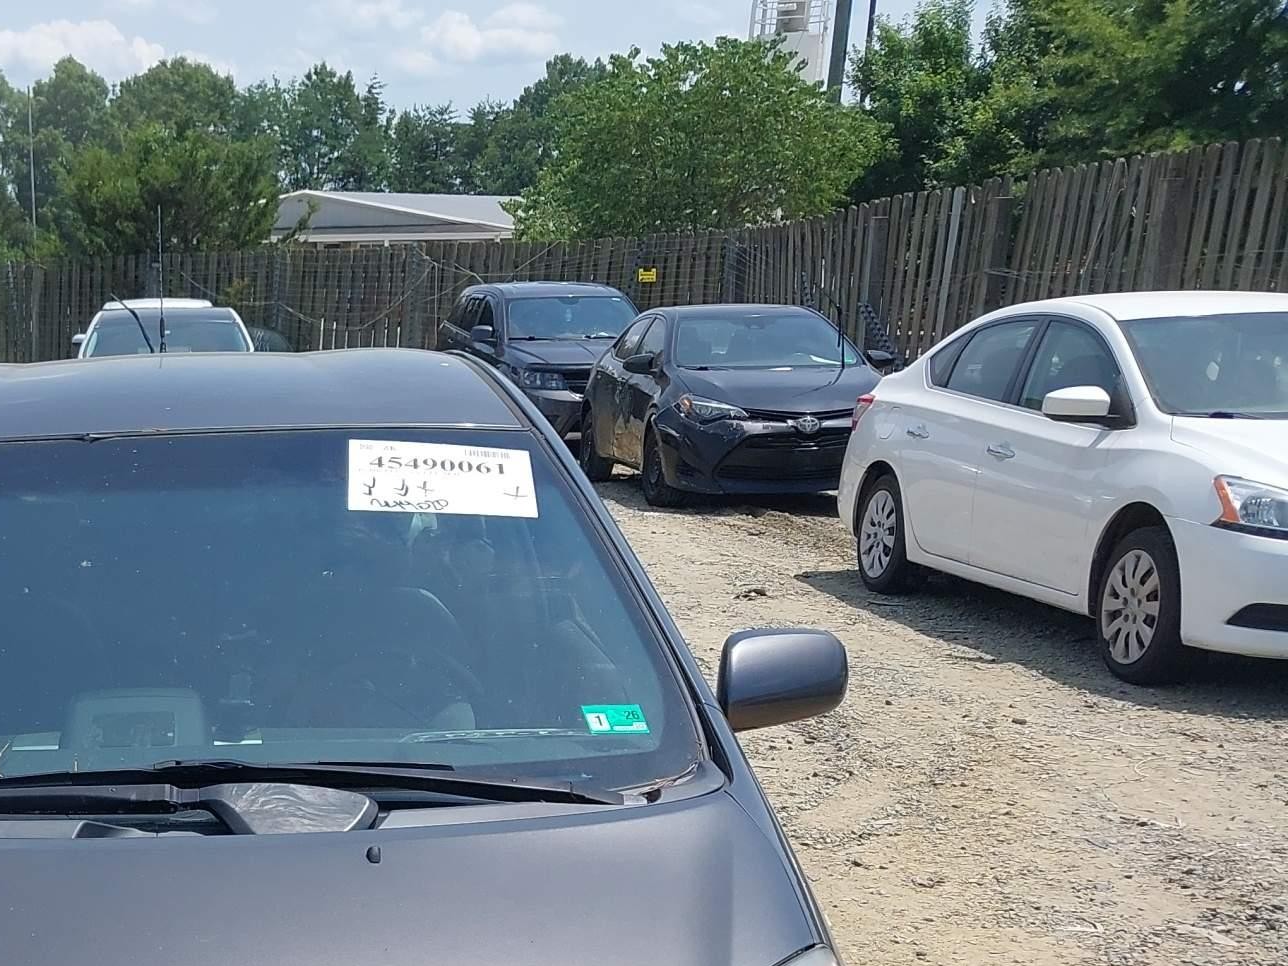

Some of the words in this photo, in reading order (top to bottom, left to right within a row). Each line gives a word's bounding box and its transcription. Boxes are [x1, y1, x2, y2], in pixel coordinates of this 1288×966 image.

[369, 455, 506, 475] 45490061
[594, 714, 603, 727] 1
[624, 710, 640, 720] 26
